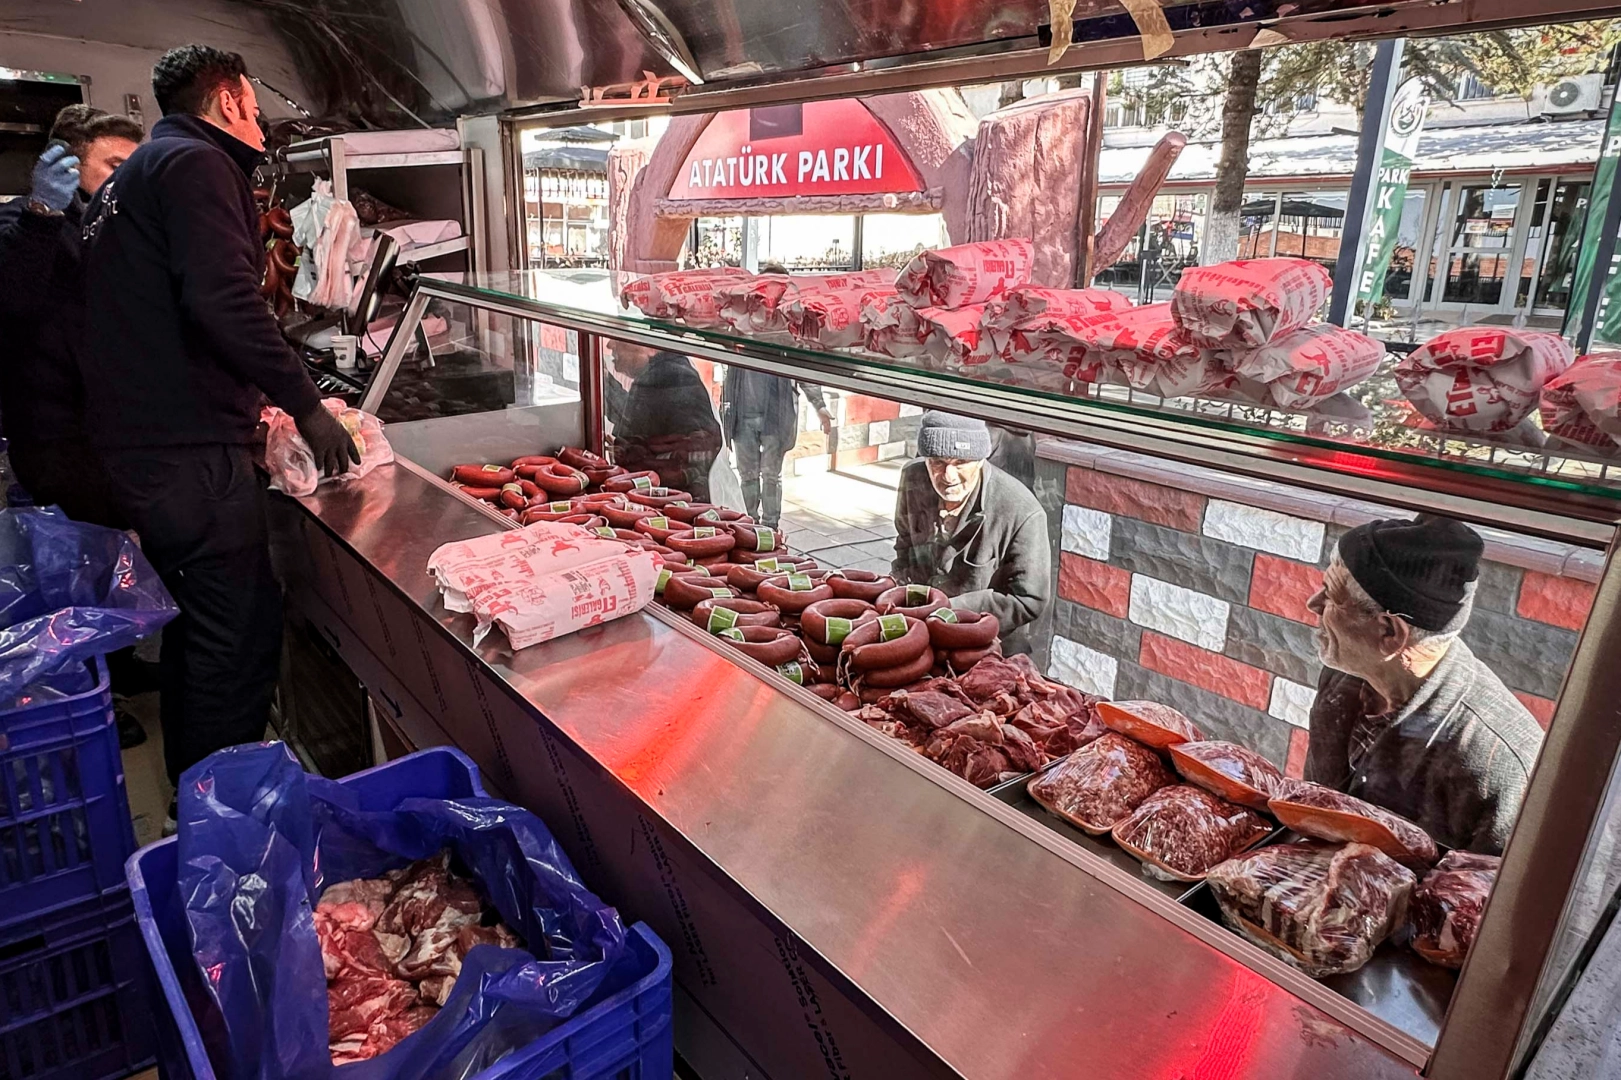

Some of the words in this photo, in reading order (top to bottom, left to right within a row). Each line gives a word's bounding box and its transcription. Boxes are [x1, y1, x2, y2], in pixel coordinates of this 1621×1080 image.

[688, 145, 788, 188] ATATÜRK
[797, 144, 883, 183] PARKI
[1378, 167, 1409, 184] PARK
[1360, 186, 1392, 293] KAFE
[601, 595, 617, 612] ET
